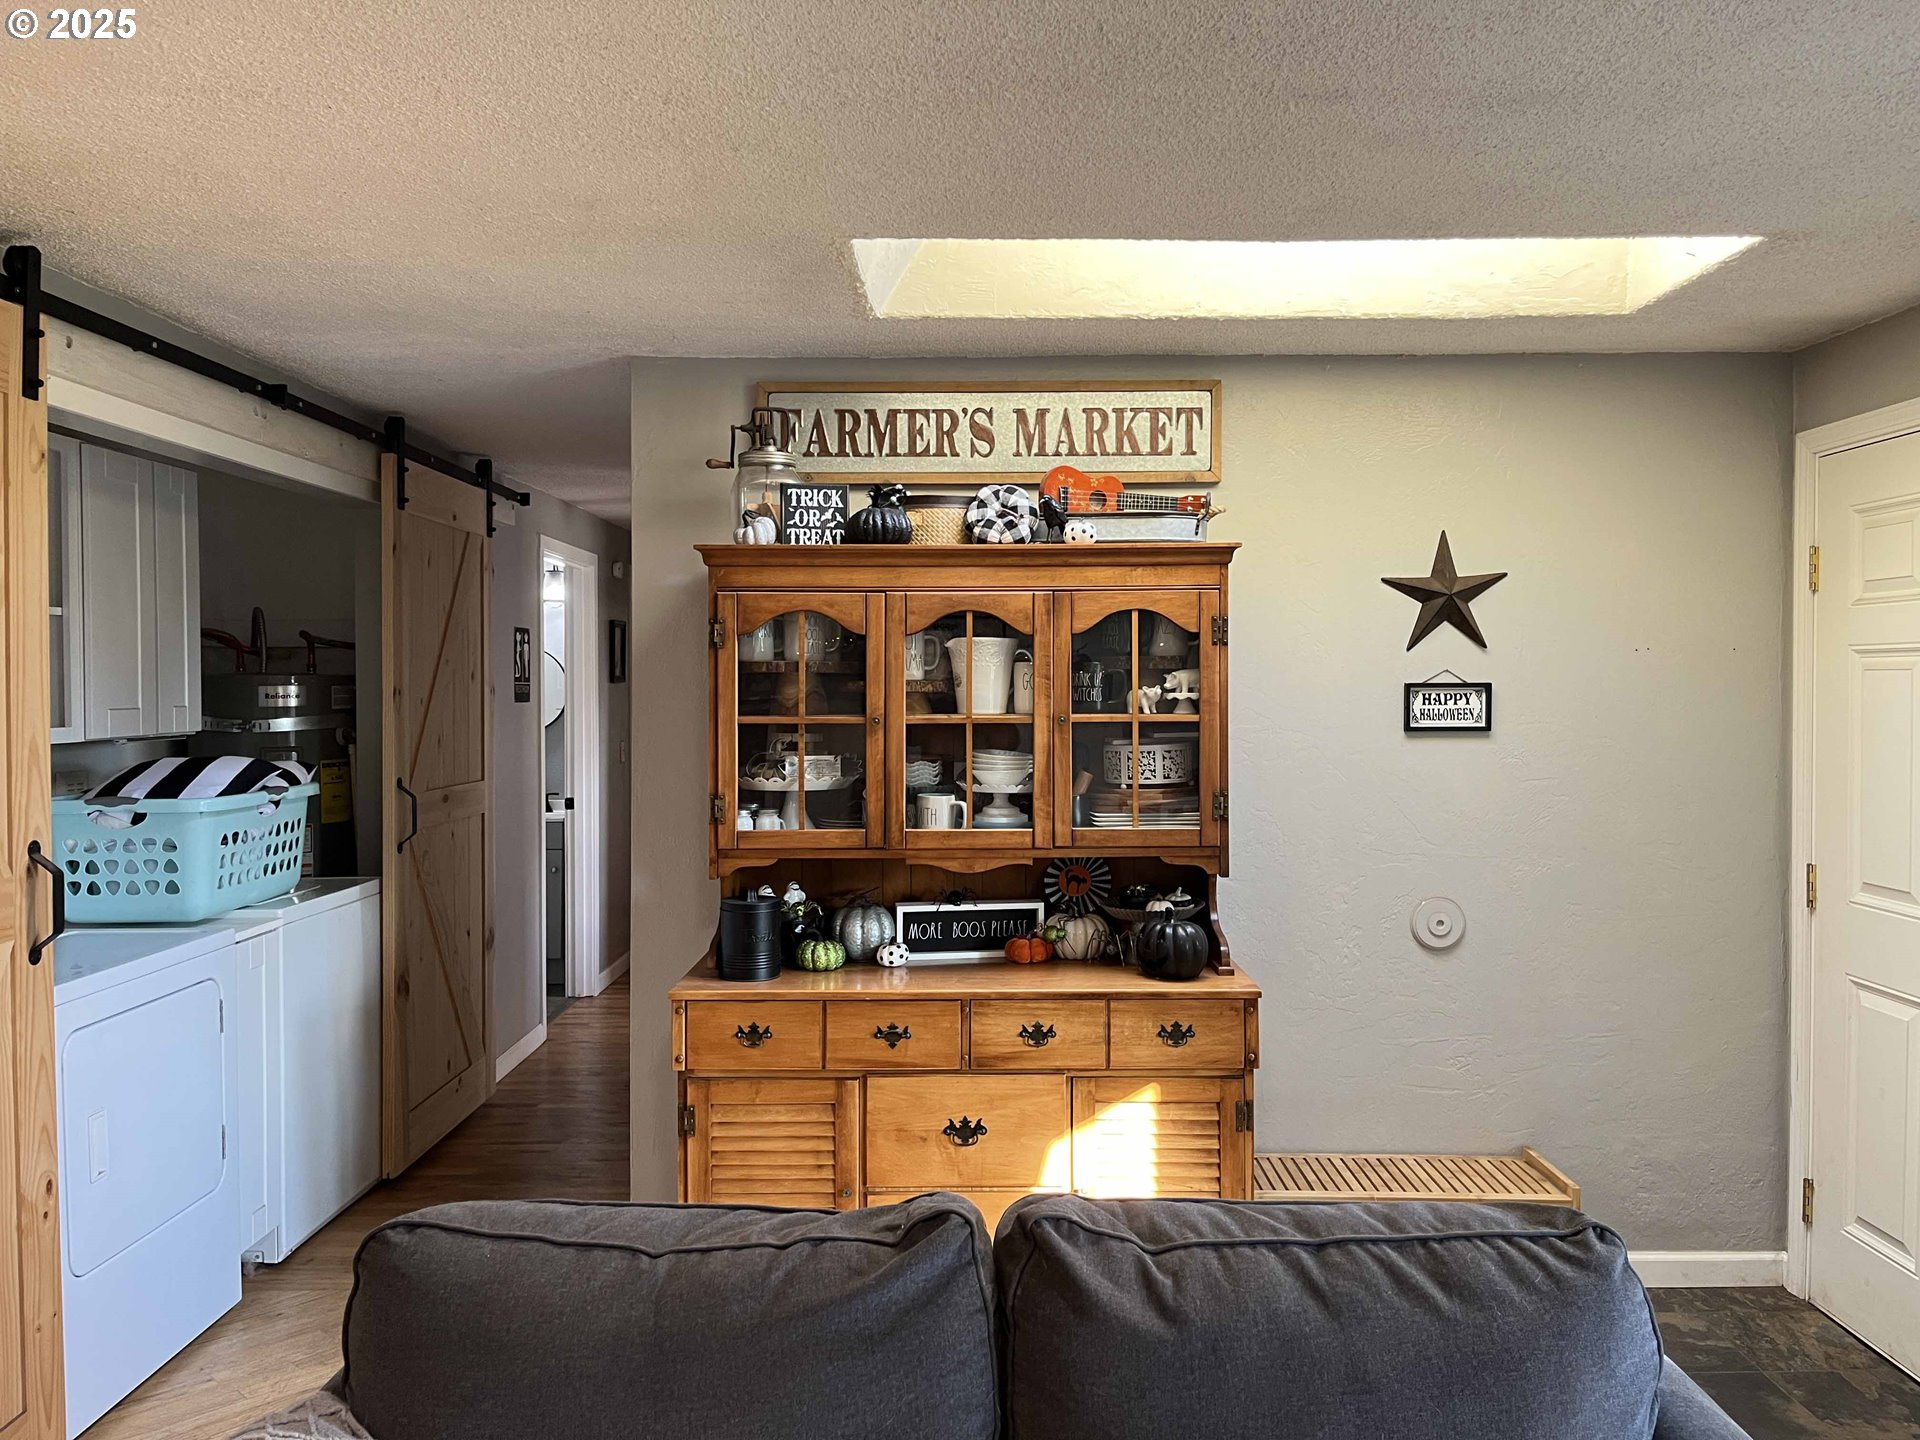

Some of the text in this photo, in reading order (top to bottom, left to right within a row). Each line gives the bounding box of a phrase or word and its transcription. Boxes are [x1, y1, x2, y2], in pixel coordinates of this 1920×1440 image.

[779, 407, 1203, 458] FARMER'S MARKET
[787, 488, 844, 508] TRICK
[794, 508, 821, 527] OR
[787, 528, 845, 545] TREAT
[264, 692, 300, 700] Reliance
[1421, 692, 1473, 706] HAPPY
[1419, 707, 1475, 722] HALLOWEEN
[908, 919, 1027, 940] MORE BOOS PLEASE
